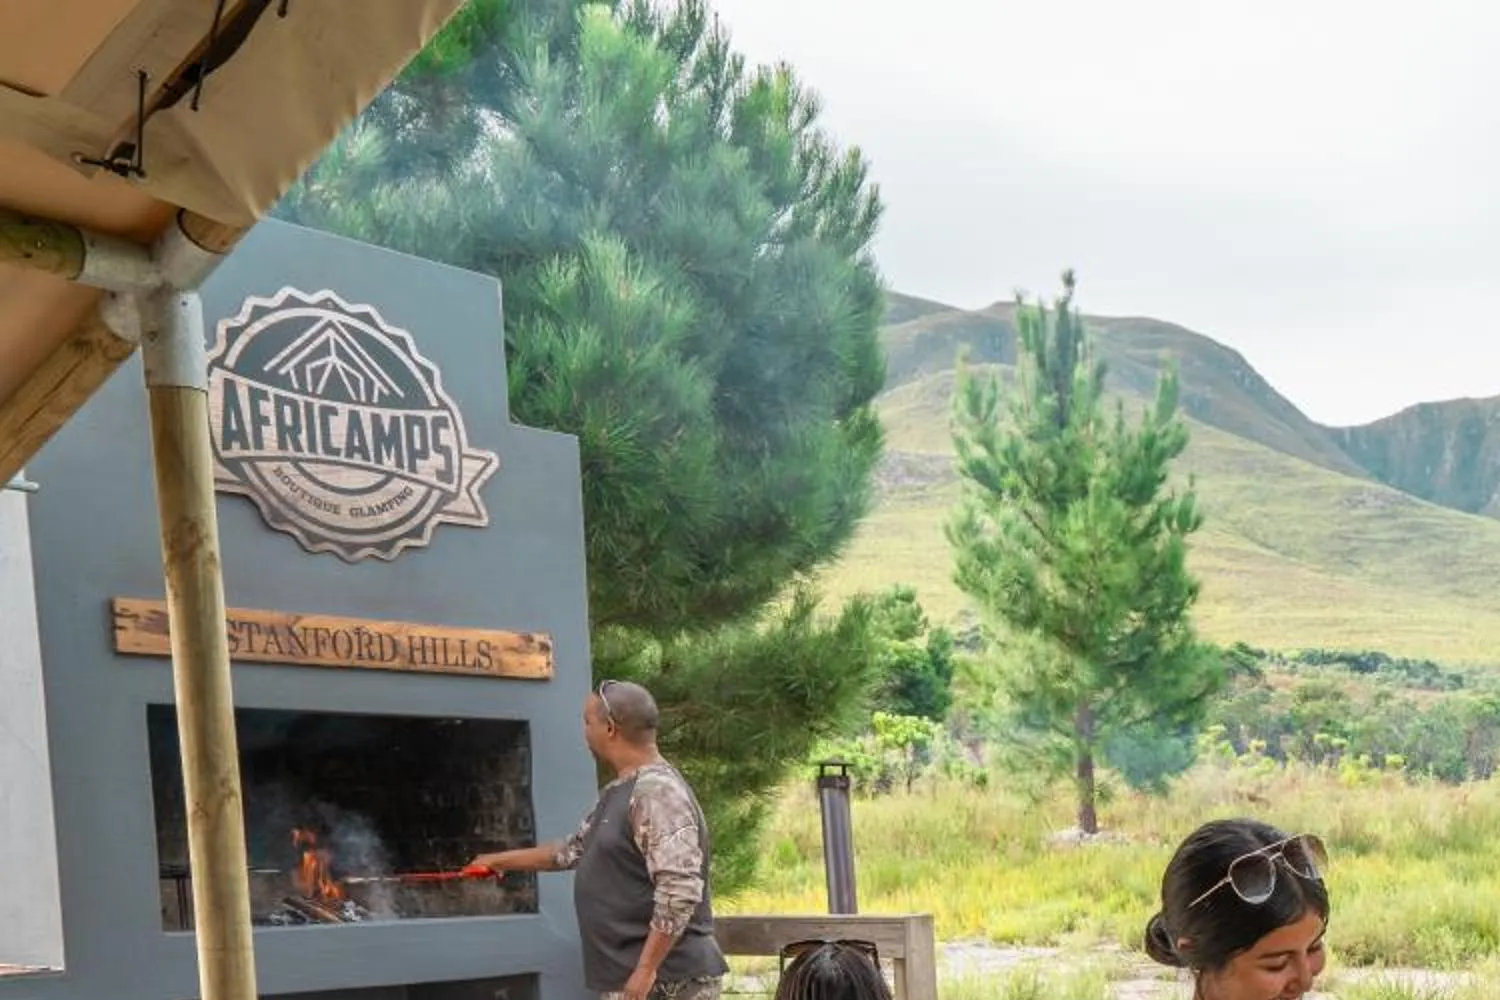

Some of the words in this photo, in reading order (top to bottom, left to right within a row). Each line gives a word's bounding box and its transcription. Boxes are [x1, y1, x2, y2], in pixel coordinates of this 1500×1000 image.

[221, 377, 451, 484] AFRICAMPS
[271, 466, 341, 515] BOUTIQUE
[348, 485, 415, 517] GLAMPING
[226, 617, 398, 663] STANFORD
[407, 633, 495, 670] HILLS
